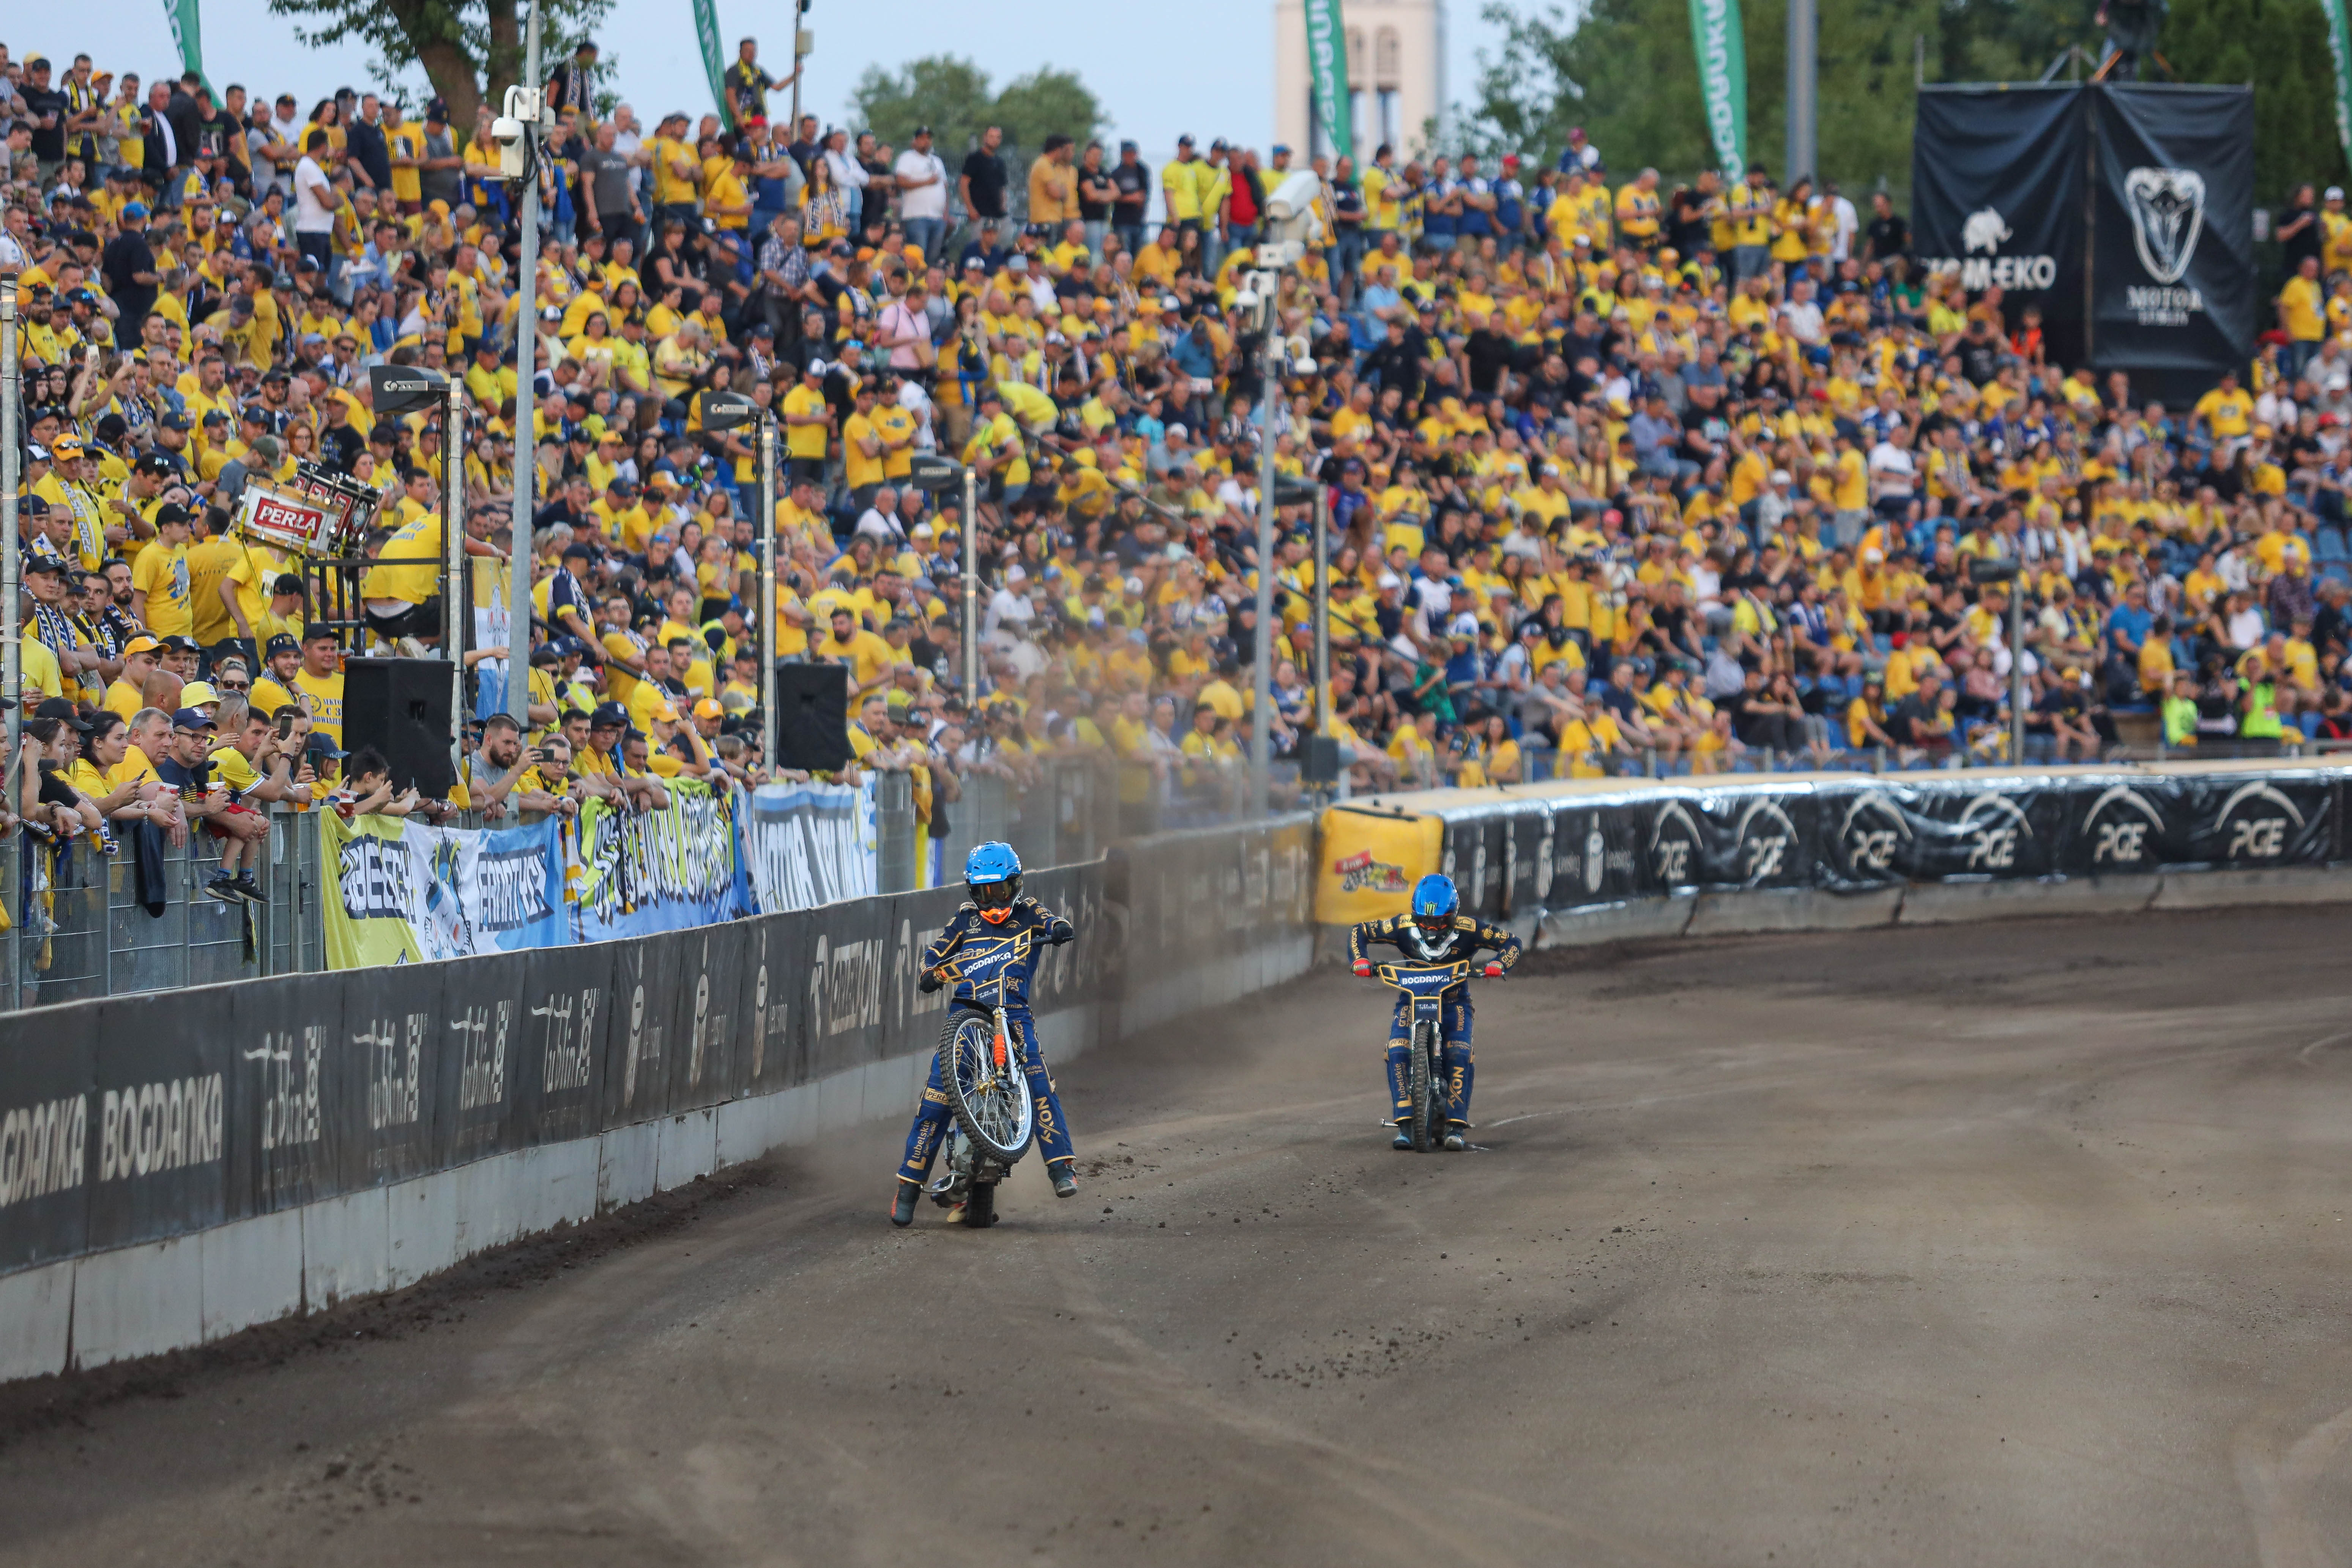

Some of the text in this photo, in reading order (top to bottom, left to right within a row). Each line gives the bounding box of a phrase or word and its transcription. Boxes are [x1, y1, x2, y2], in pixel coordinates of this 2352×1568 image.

[2094, 822, 2147, 862] PGE
[2228, 818, 2286, 859] PGE
[963, 952, 1011, 977] BOGDANKA
[1402, 975, 1450, 985] BOGDANKA
[99, 1073, 222, 1182] BOGDANKA
